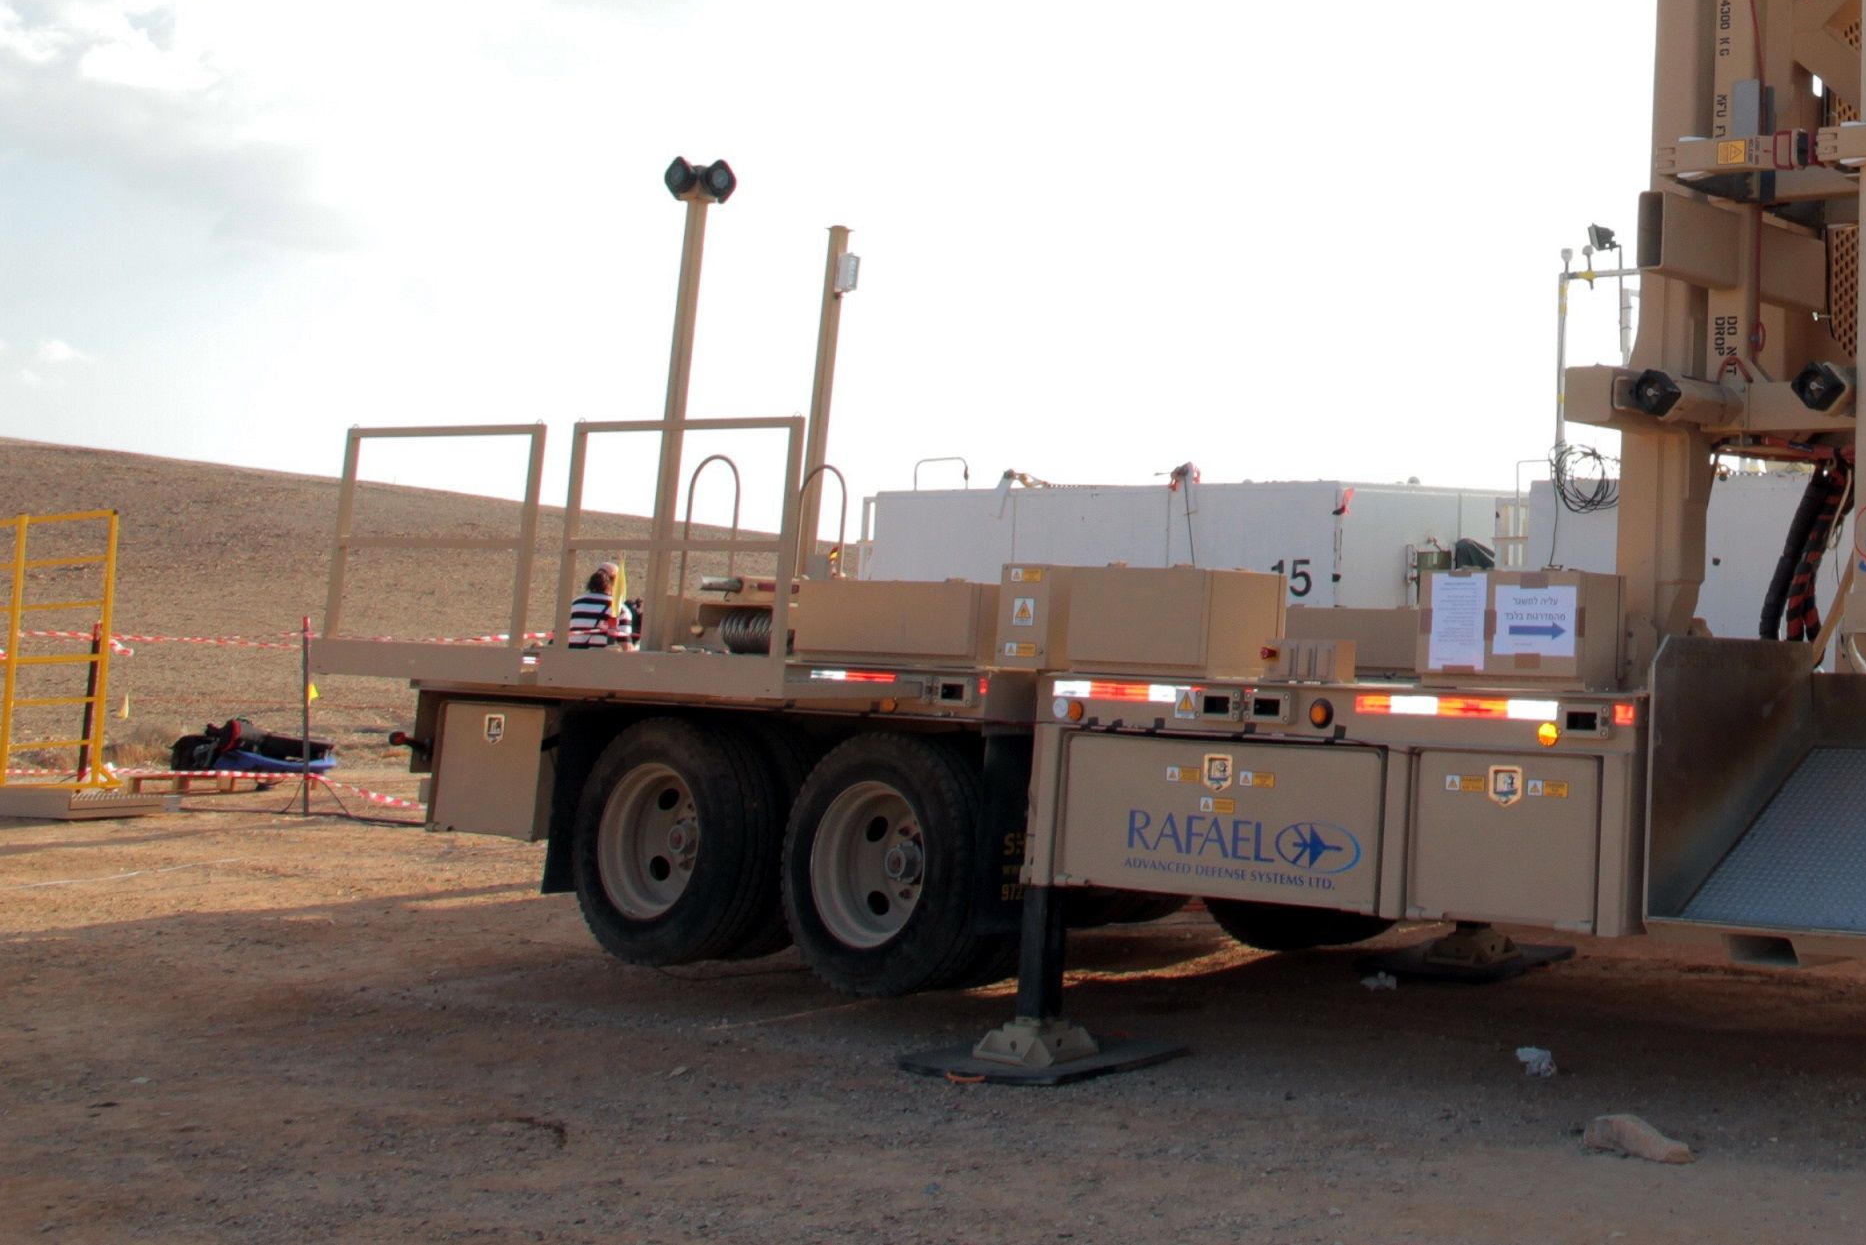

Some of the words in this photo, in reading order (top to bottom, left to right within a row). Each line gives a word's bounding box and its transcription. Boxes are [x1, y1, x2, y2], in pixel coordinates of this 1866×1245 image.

[1719, 0, 1731, 31] 4300
[1716, 94, 1728, 118] MFU
[1715, 316, 1725, 356] DROP
[1727, 316, 1737, 336] DO
[1127, 809, 1275, 863] RAFAEL
[1124, 857, 1192, 875] ADVANCED
[1196, 865, 1246, 881] DEFENSE
[1250, 870, 1305, 887] SYSTEMS
[1308, 877, 1336, 890] LTD.
